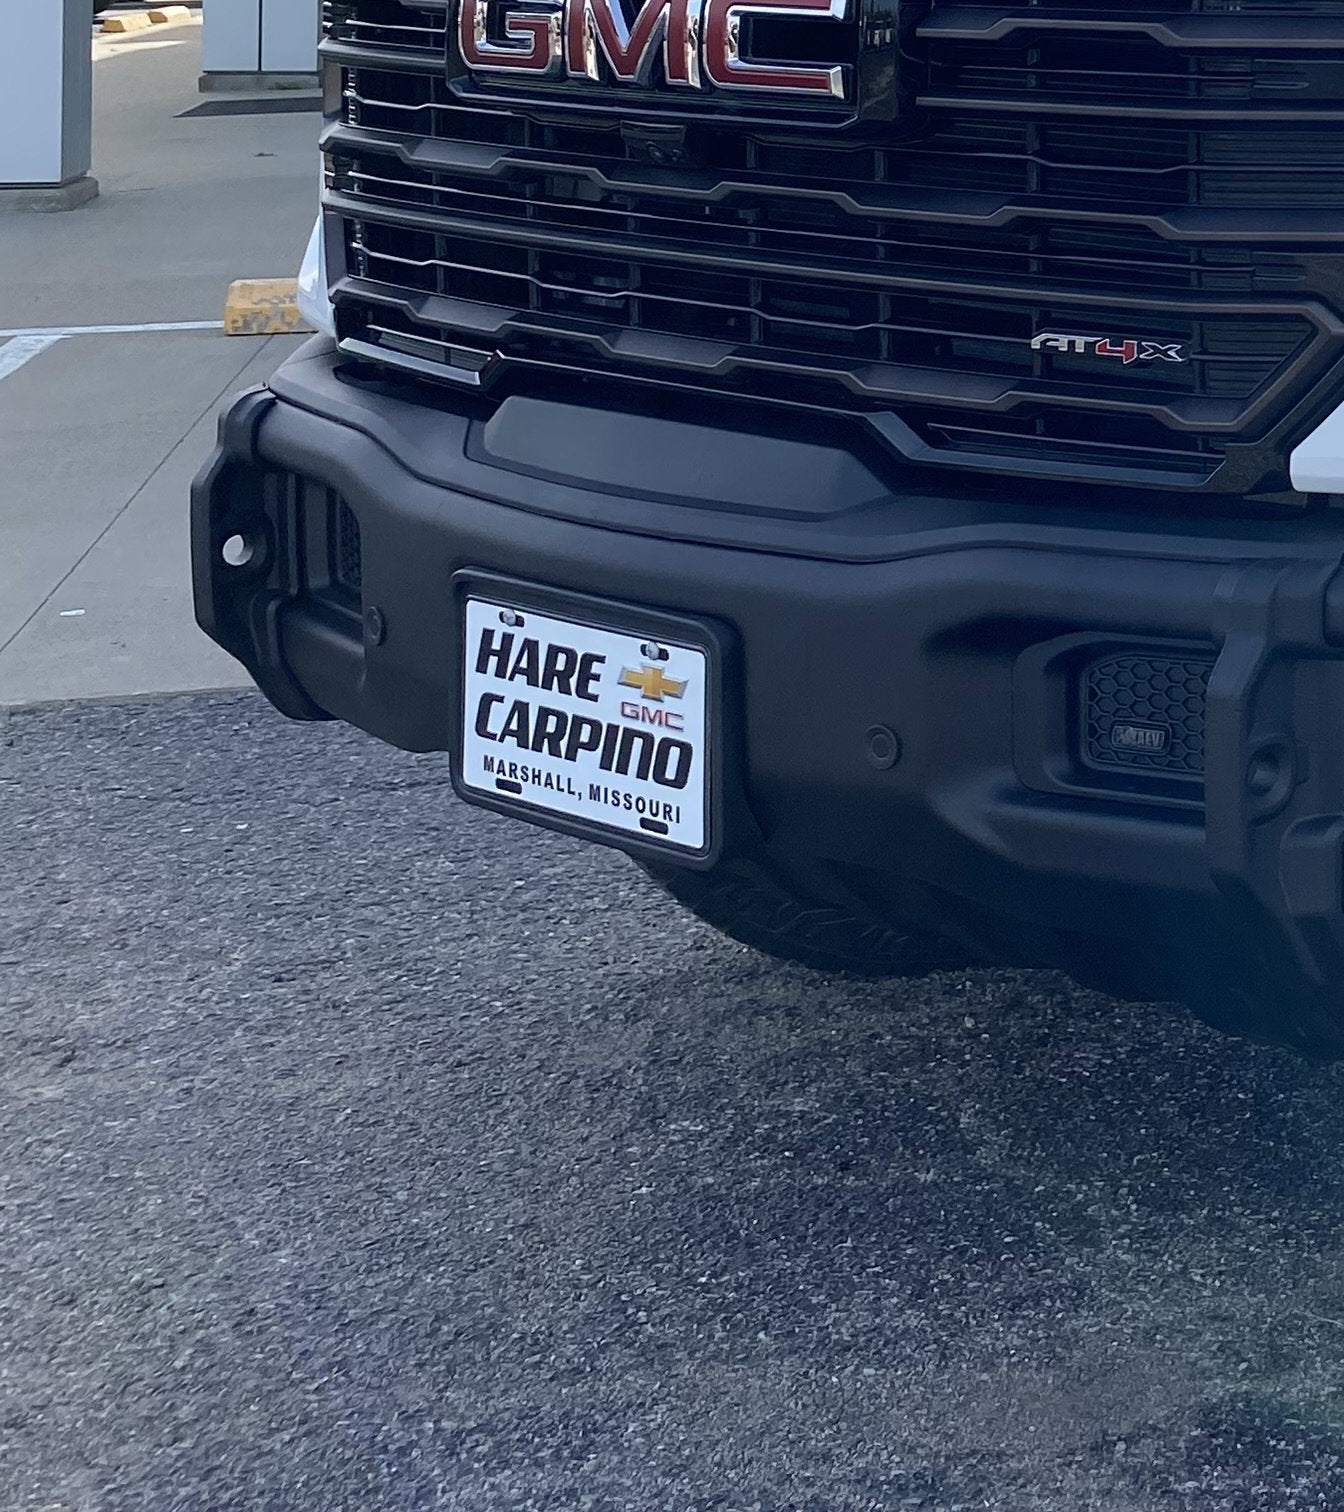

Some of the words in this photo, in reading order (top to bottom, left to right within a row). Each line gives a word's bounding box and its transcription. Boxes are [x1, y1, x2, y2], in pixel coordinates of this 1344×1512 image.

[1030, 333, 1184, 365] AT4X
[475, 627, 607, 703] HARE
[474, 691, 694, 790] CARPINO
[620, 700, 685, 732] GMC
[483, 754, 582, 802] MARSHALL,
[588, 783, 681, 824] MISSOURI
